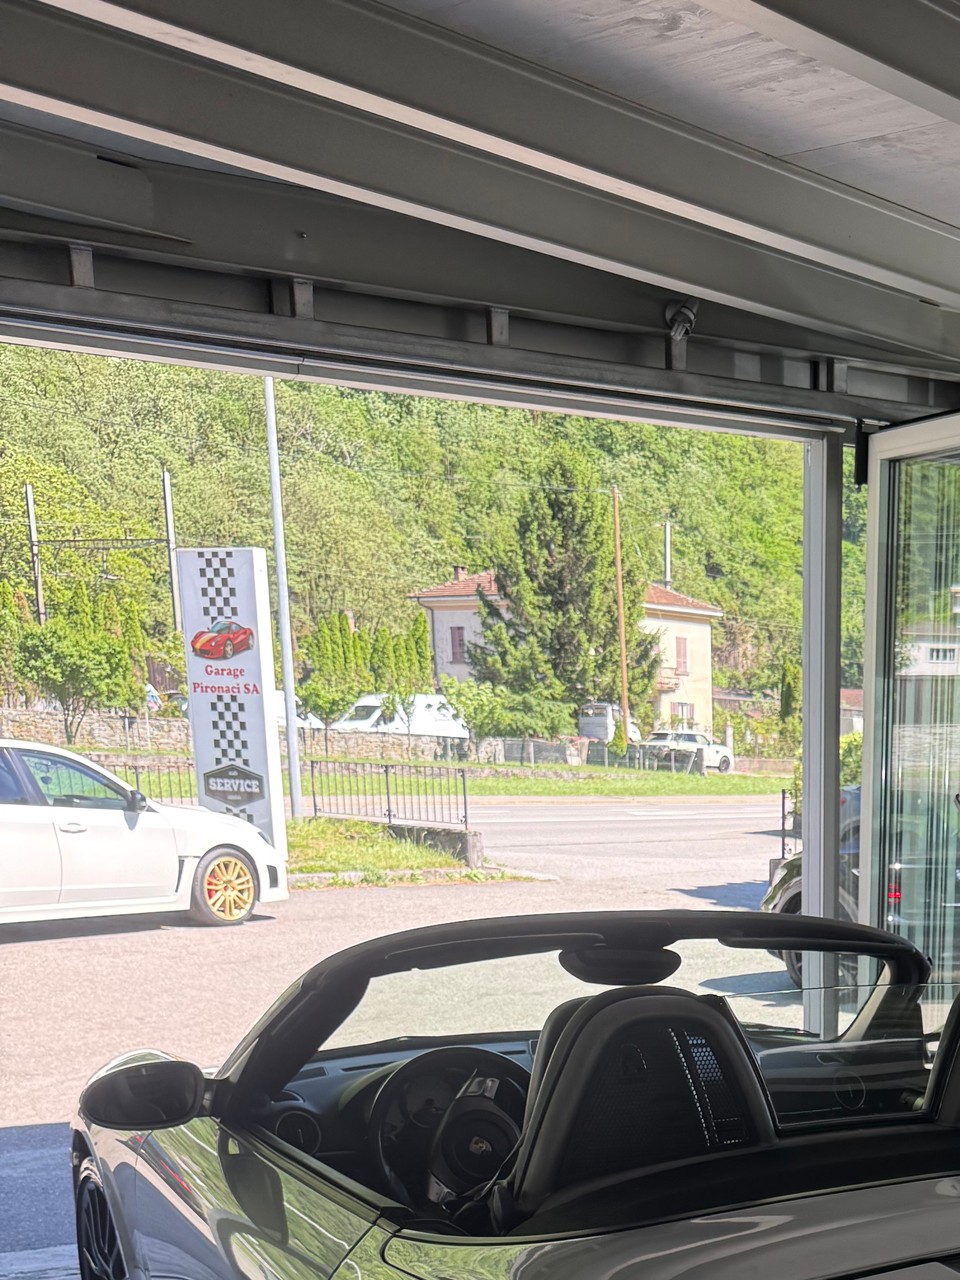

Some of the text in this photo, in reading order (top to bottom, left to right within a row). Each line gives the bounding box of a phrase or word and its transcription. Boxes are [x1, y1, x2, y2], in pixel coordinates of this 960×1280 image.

[204, 665, 245, 678] Garage
[192, 682, 260, 695] Pironaci SA
[209, 778, 260, 793] SERVICE
